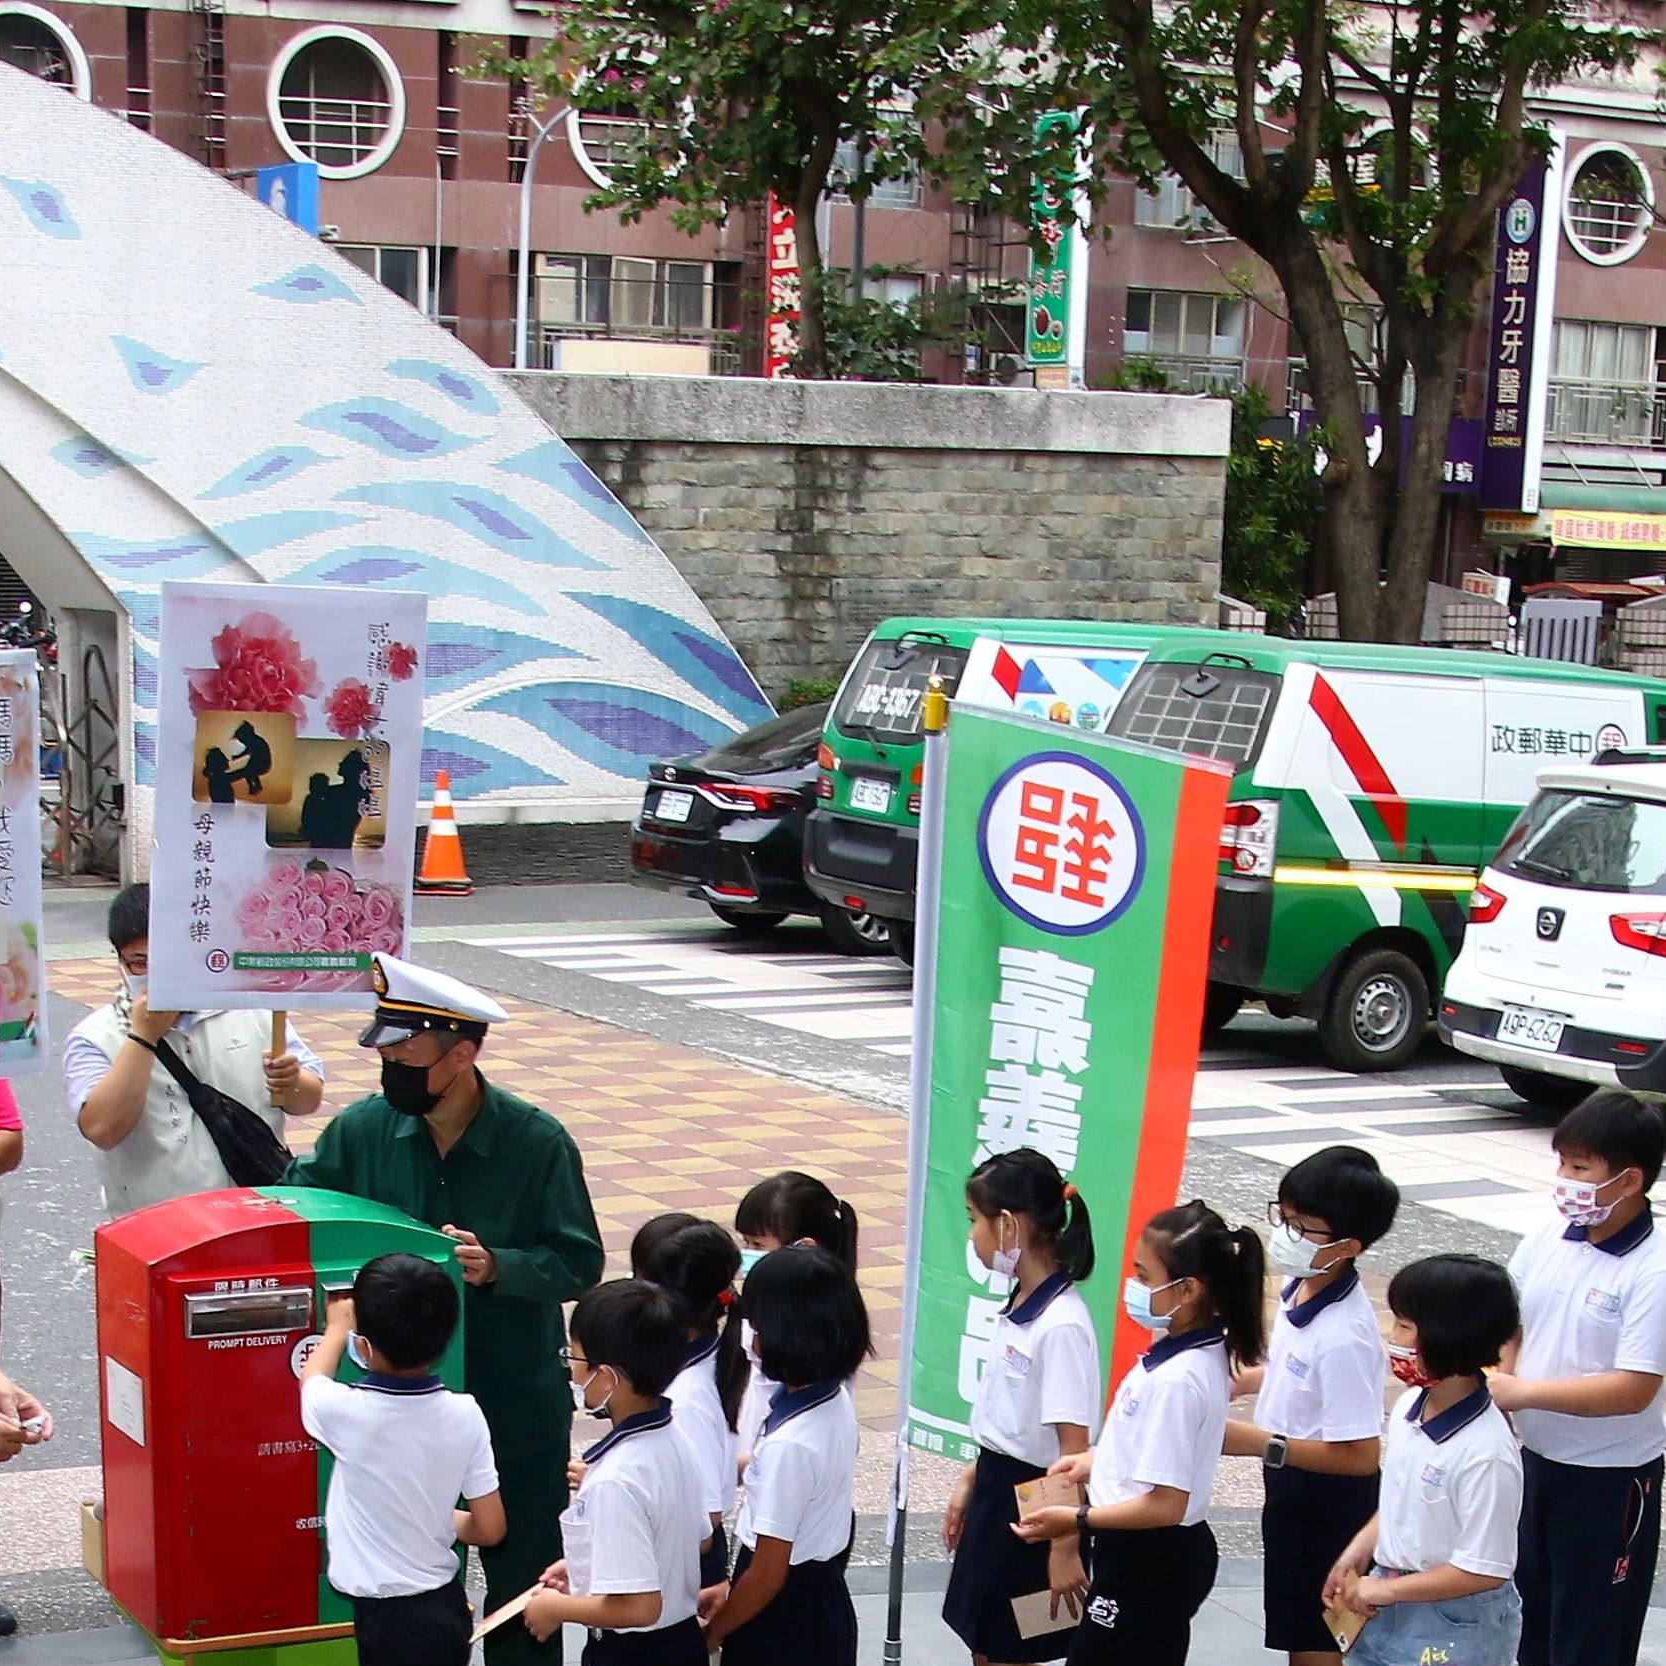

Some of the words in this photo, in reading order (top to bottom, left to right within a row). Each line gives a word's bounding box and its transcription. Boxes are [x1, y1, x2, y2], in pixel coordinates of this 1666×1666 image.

[189, 812, 216, 944] 母親節快樂
[214, 1277, 280, 1293] 限時郵件
[208, 1337, 245, 1350] PROMPT
[246, 1335, 288, 1348] DELIVERY
